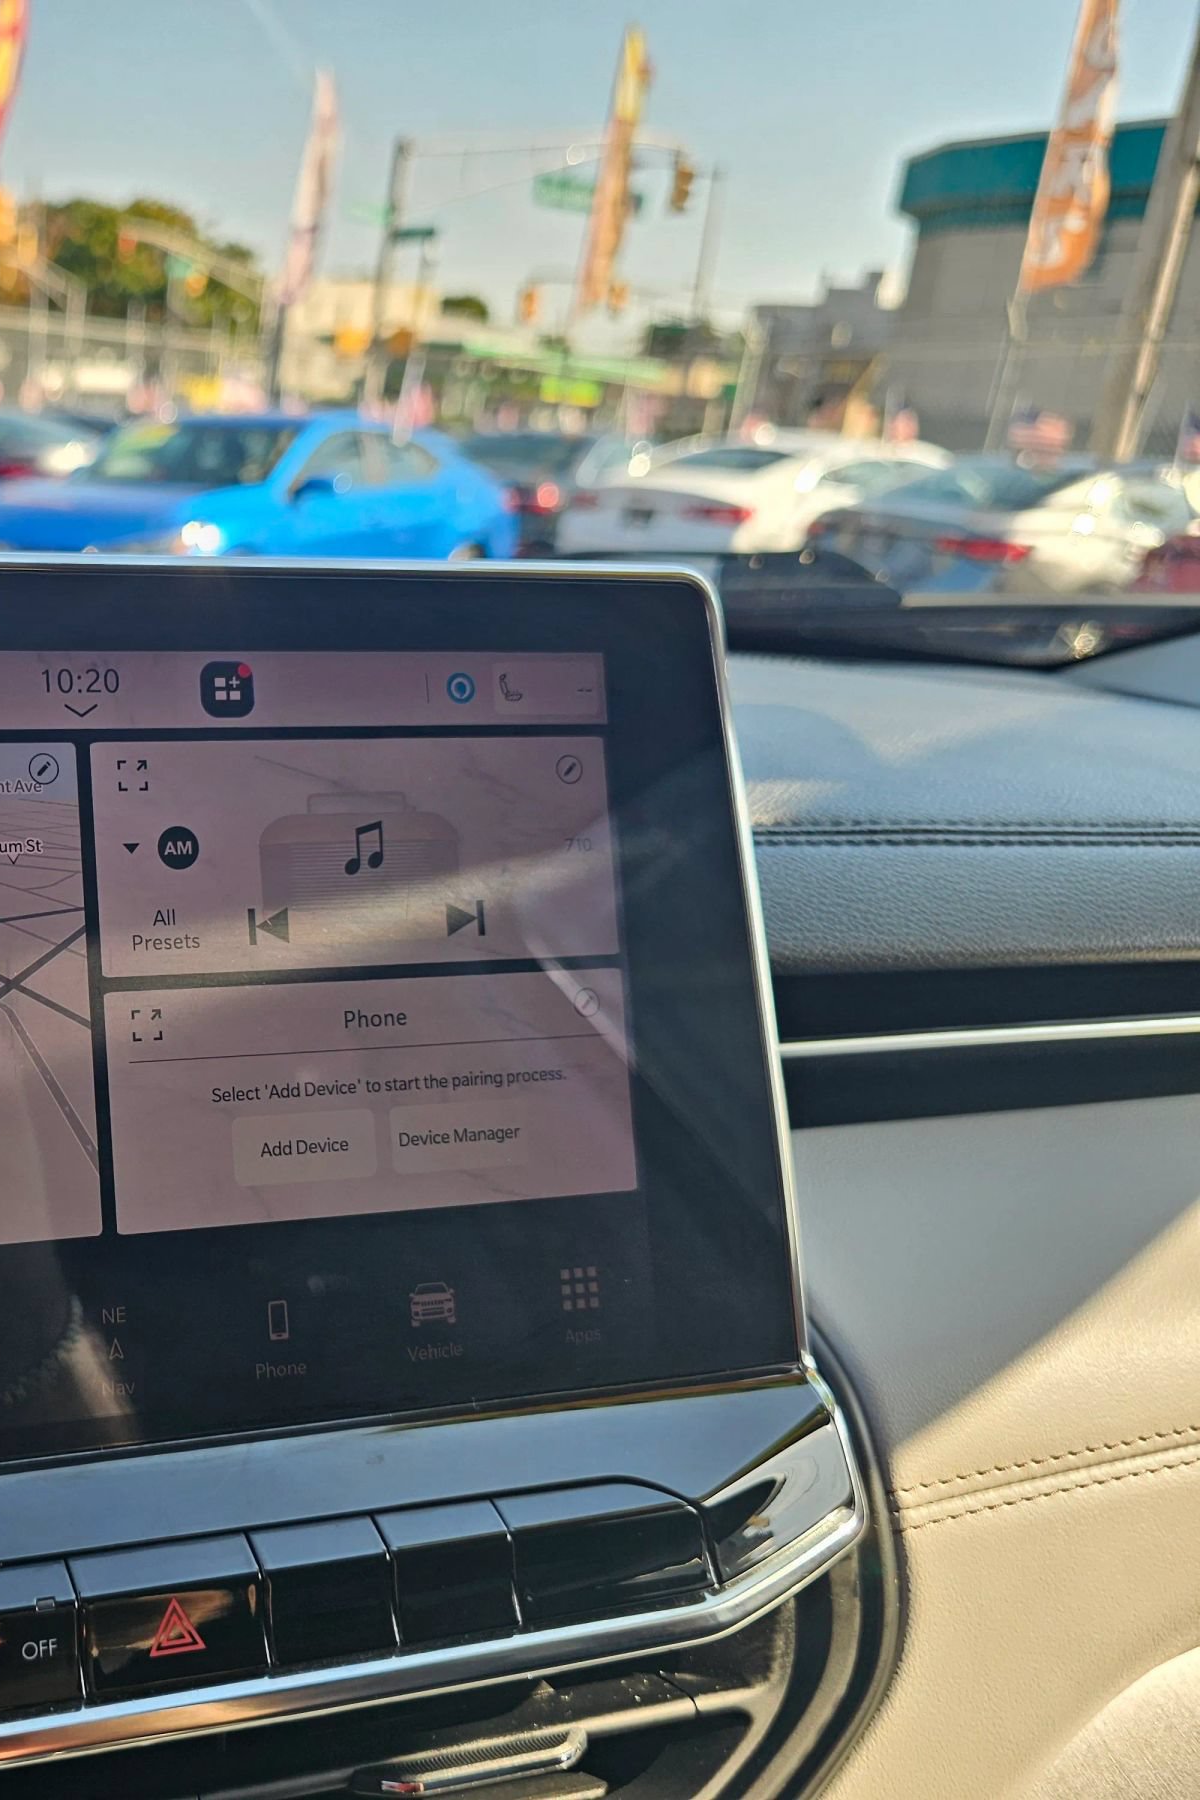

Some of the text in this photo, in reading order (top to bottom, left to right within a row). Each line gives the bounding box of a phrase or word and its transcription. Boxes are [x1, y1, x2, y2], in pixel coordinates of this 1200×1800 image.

[42, 668, 120, 693] 10:20
[13, 780, 42, 793] Ave
[26, 838, 42, 854] St
[164, 840, 192, 856] AM
[564, 838, 592, 852] 710
[152, 908, 176, 927] All
[132, 932, 200, 952] Presets
[343, 1007, 407, 1030] Phone
[211, 1068, 567, 1103] Select 'Add Device' to start the pairing process.
[399, 1124, 521, 1148] Device Manager
[260, 1136, 349, 1159] Add Device
[102, 1306, 127, 1324] NE
[564, 1326, 602, 1346] Apps
[407, 1342, 464, 1362] Vehicle
[255, 1360, 307, 1379] Phone
[22, 1639, 58, 1660] OFF
